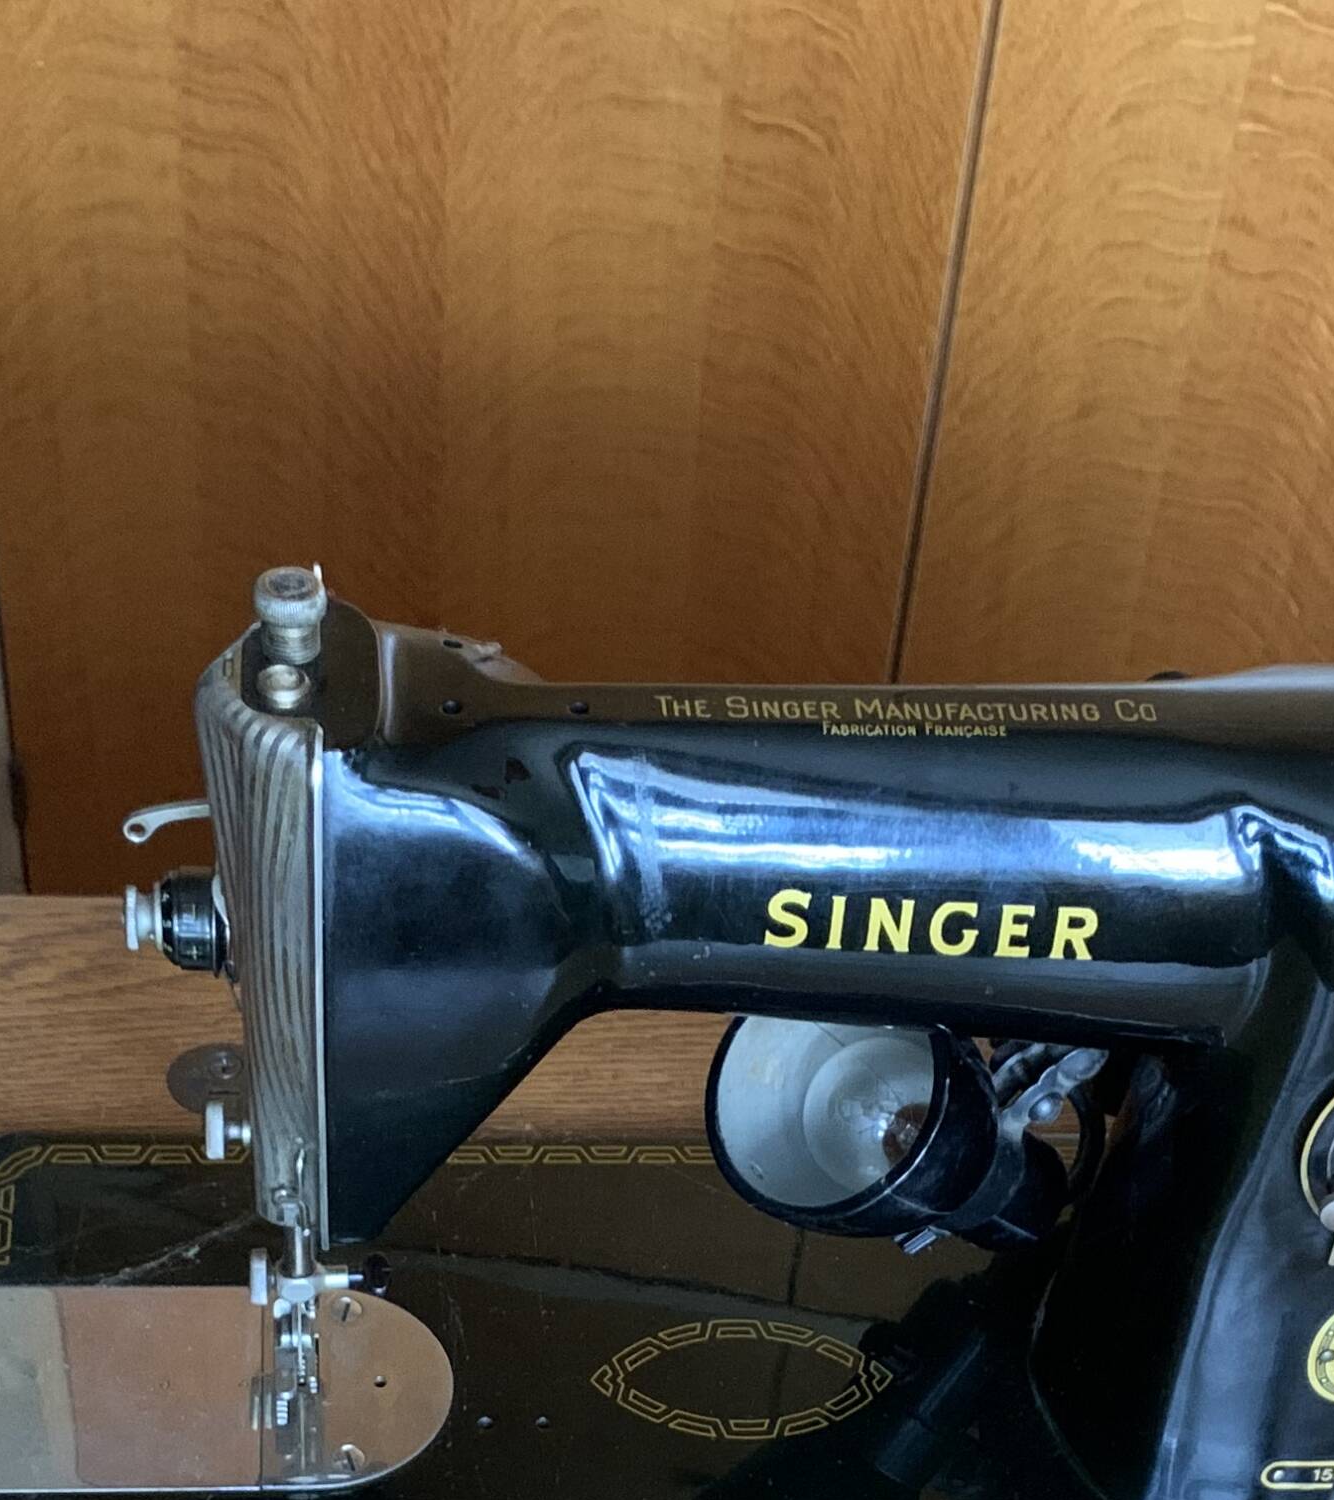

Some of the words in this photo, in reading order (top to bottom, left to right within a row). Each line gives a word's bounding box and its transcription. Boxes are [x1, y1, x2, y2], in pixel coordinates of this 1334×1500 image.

[654, 695, 711, 718] THE
[725, 696, 840, 720] SINGER
[854, 698, 1100, 722] MANUFACTURING
[822, 720, 916, 736] FABRICATION
[925, 722, 1007, 738] FRANÇAISE
[764, 888, 1099, 961] SINGER
